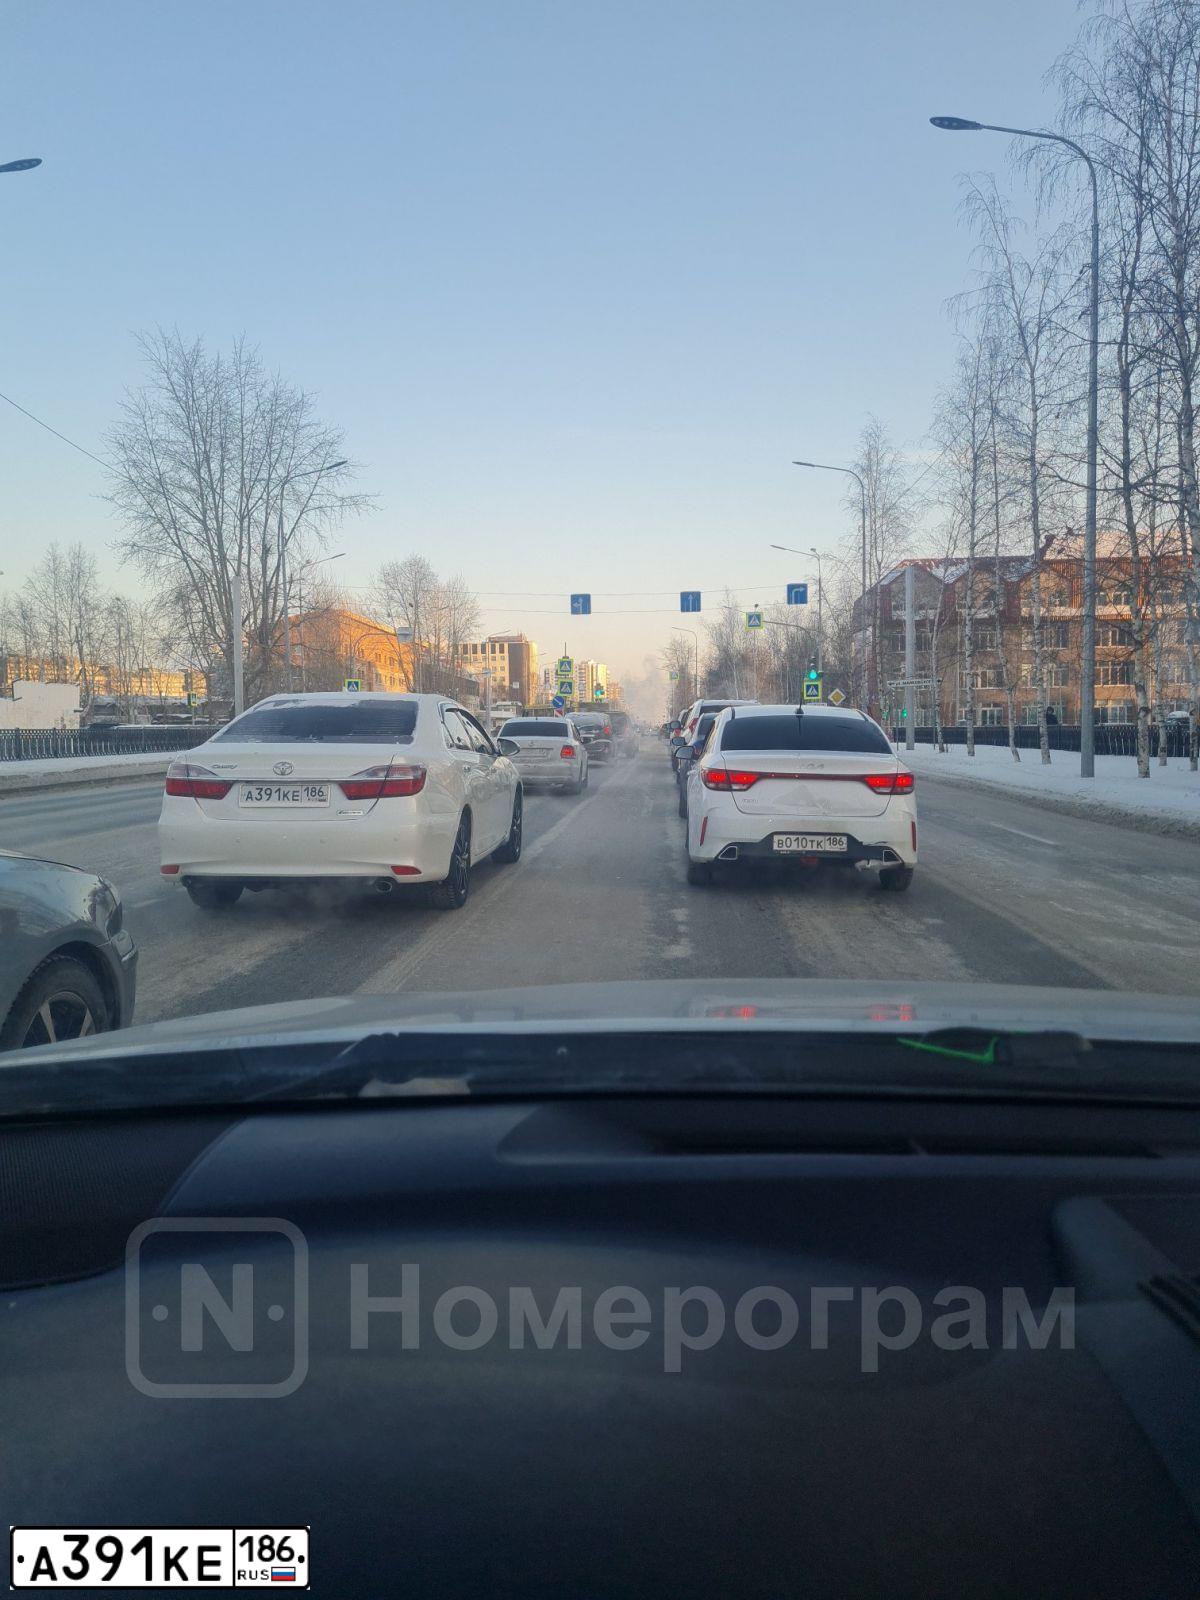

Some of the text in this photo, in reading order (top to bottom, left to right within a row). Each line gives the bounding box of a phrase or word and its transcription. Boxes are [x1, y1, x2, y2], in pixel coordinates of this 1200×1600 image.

[245, 786, 324, 802] А391КЕ 186
[777, 836, 844, 849] В010ТК 186
